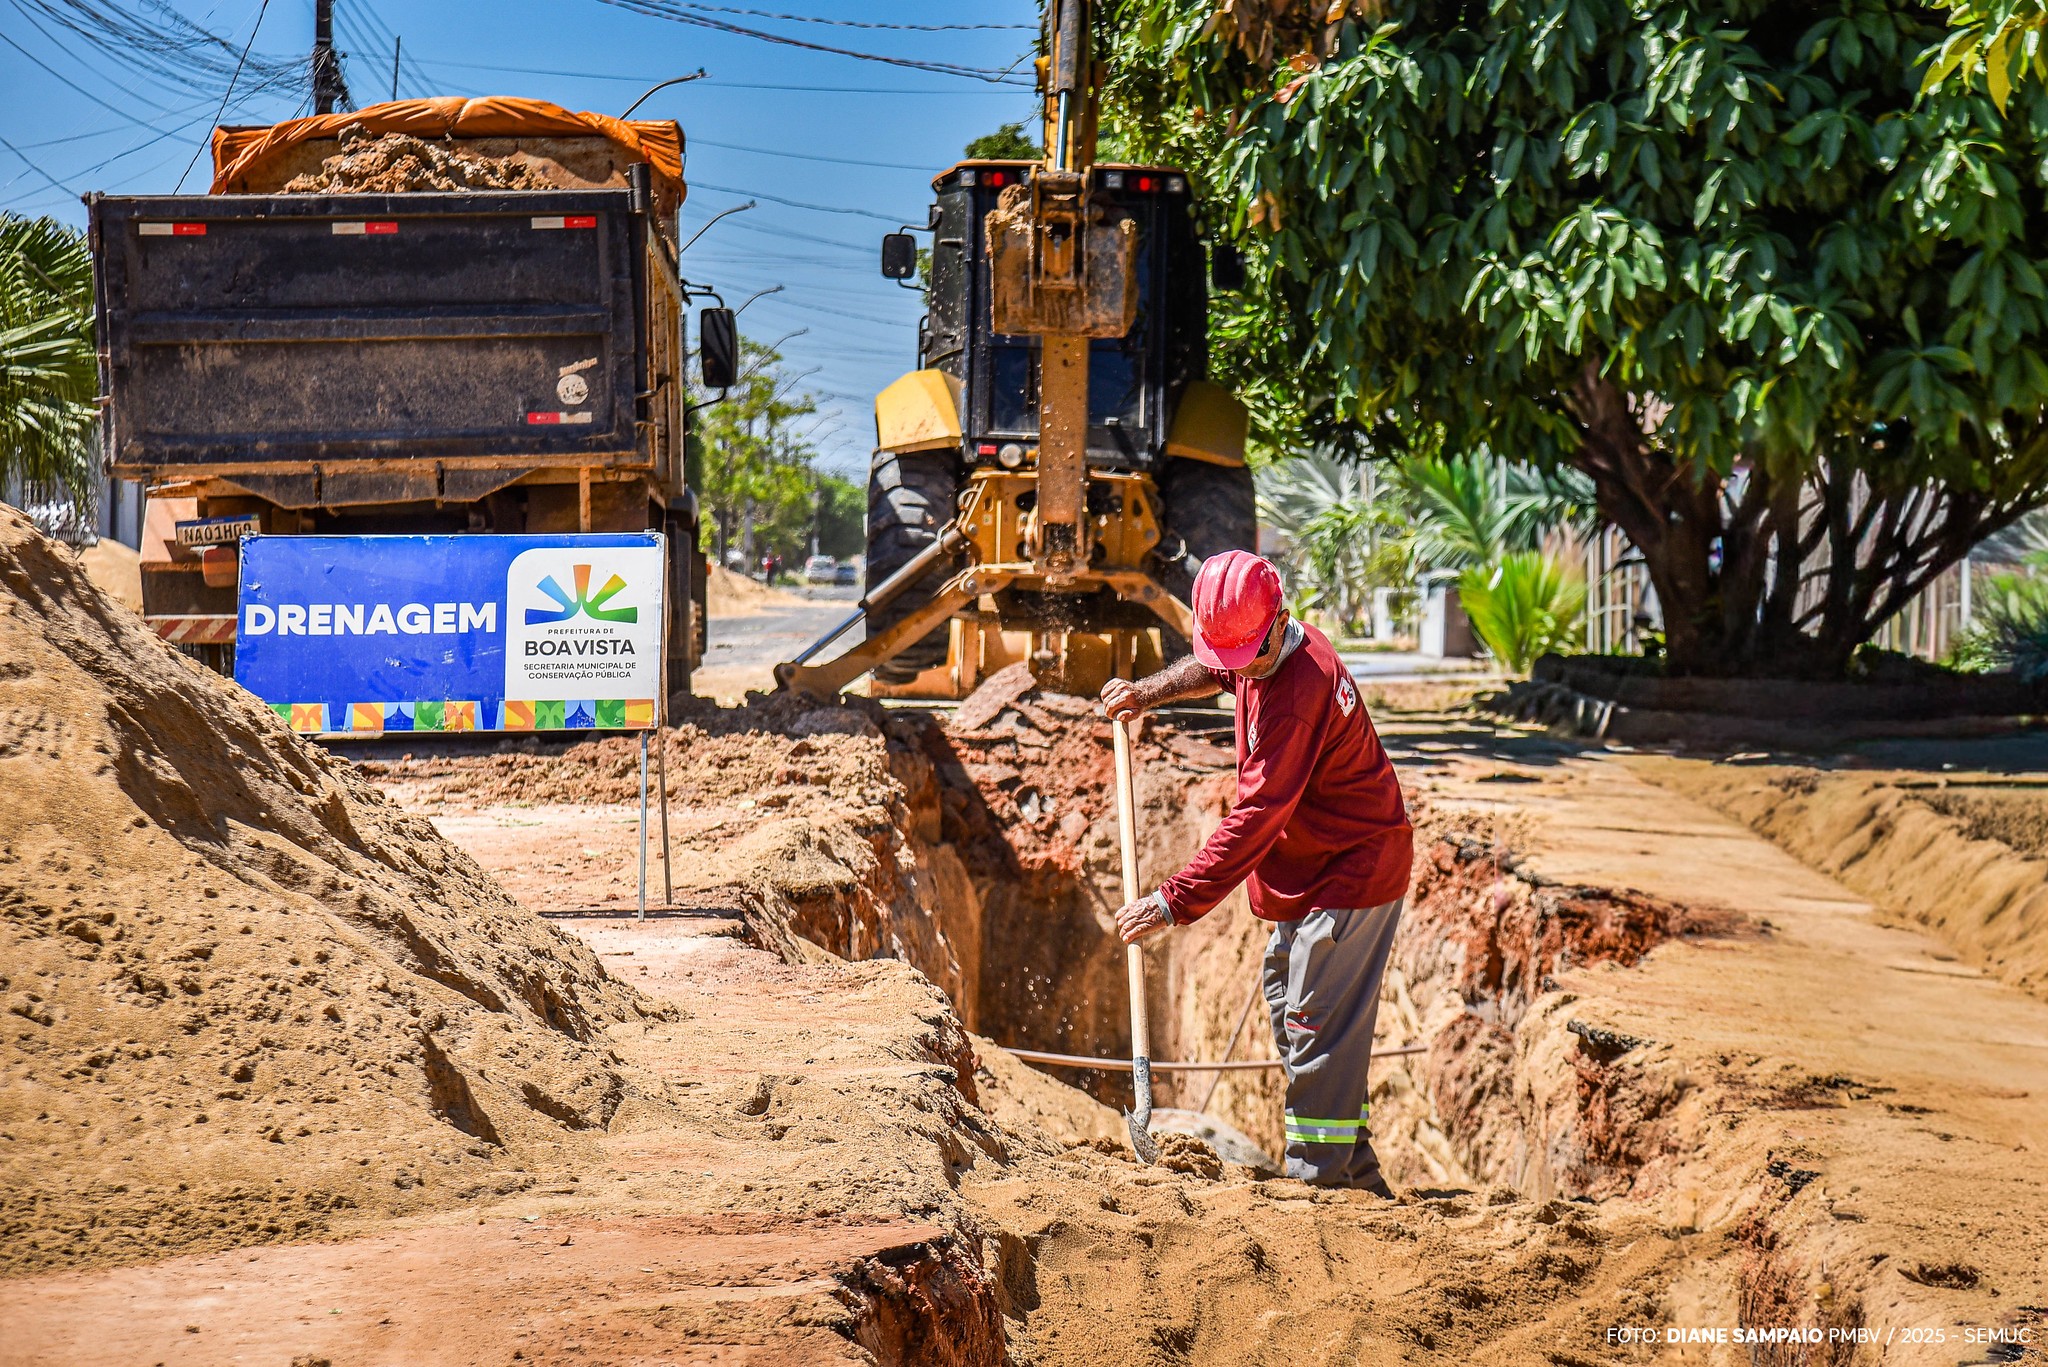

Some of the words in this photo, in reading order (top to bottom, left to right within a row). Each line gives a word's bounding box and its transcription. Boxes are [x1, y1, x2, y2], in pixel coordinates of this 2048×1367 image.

[244, 602, 497, 636] DRENAGEM
[525, 640, 572, 656] BOA
[573, 639, 636, 655] VISTA
[523, 663, 575, 671] SECRETARIA
[576, 662, 624, 670] MUNICIPAL
[625, 661, 637, 669] DE
[528, 670, 594, 681] CONSERVAÇÃO
[595, 670, 631, 679] PÚBLICA
